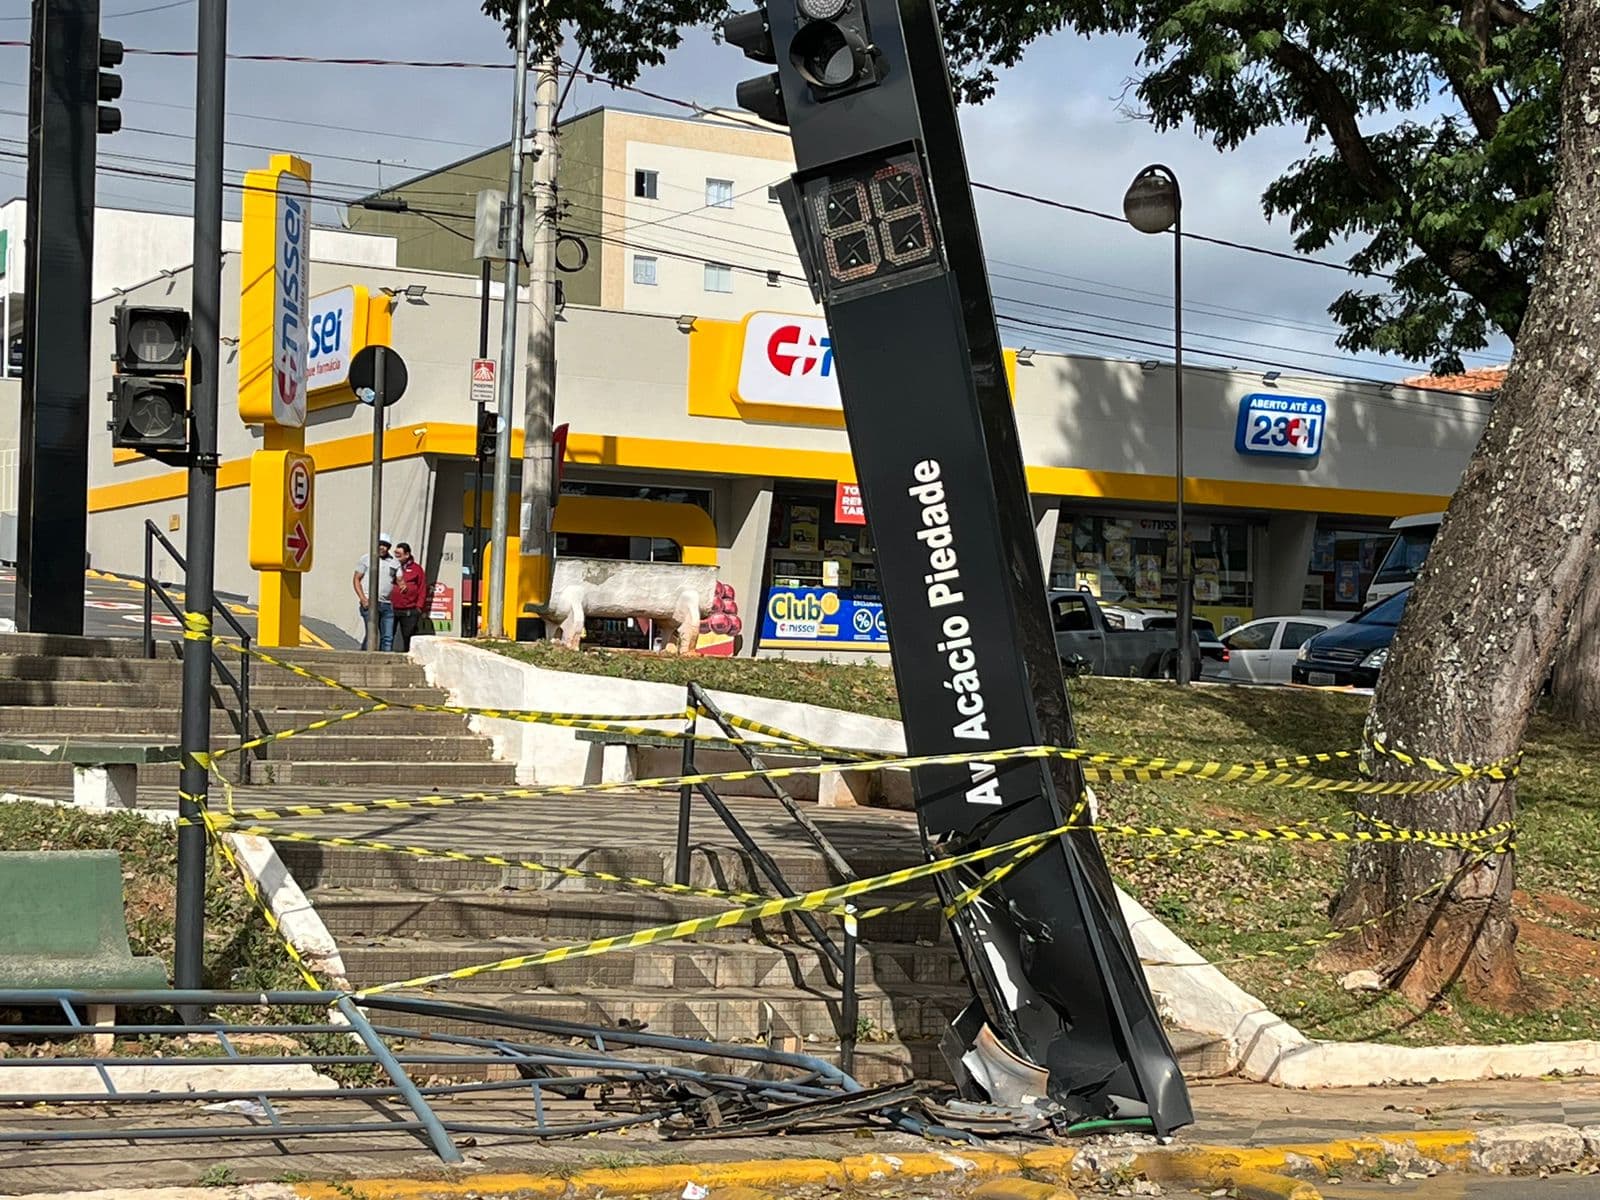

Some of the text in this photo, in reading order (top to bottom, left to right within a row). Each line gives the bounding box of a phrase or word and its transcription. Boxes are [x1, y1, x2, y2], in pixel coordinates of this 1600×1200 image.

[281, 196, 301, 353] nissei
[1250, 399, 1288, 410] ABERTO
[1289, 401, 1308, 412] ATÉ
[908, 458, 965, 608] Piedade
[771, 596, 821, 620] Club
[937, 614, 991, 740] Acácio
